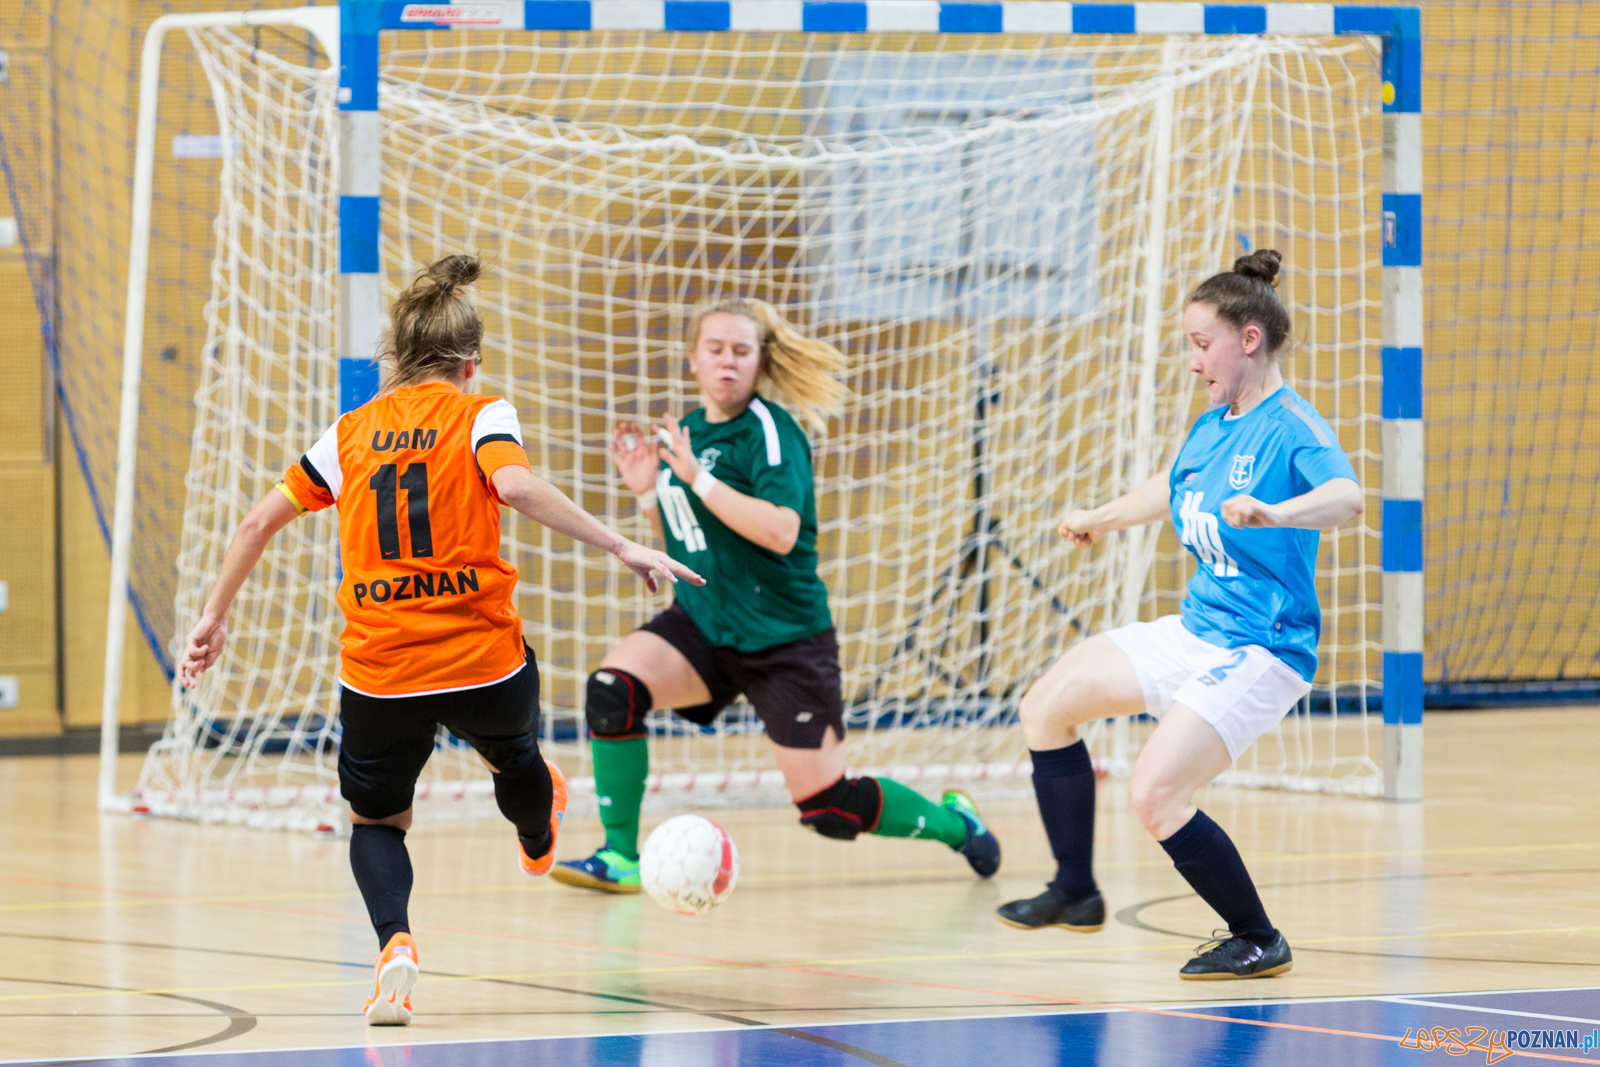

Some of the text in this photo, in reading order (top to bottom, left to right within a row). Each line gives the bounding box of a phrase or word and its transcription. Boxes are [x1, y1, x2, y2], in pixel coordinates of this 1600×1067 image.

[371, 428, 438, 452] UAM
[369, 462, 434, 560] 11
[353, 564, 480, 607] POZNAŃ
[1208, 649, 1248, 682] 2
